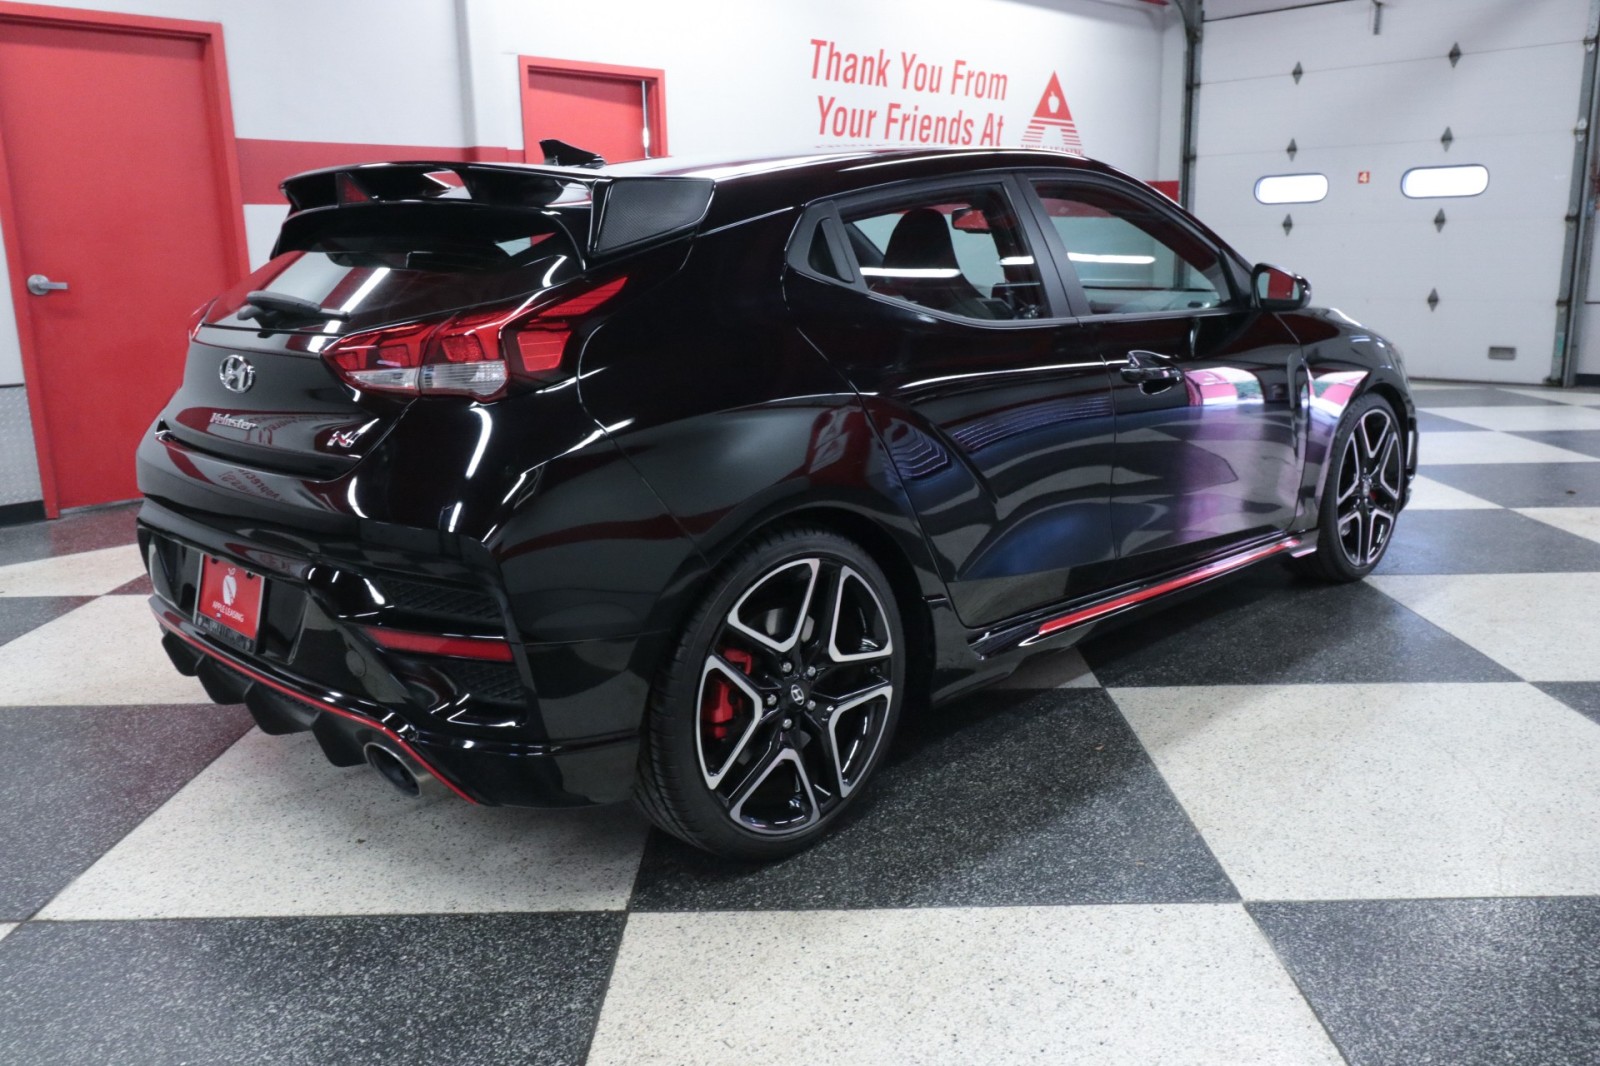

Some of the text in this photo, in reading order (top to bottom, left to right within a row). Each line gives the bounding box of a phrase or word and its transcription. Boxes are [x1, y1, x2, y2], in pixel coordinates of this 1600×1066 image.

[809, 38, 1009, 101] Thank You From
[817, 95, 1004, 147] Your Friends At
[212, 600, 244, 622] APPLE LEASING
